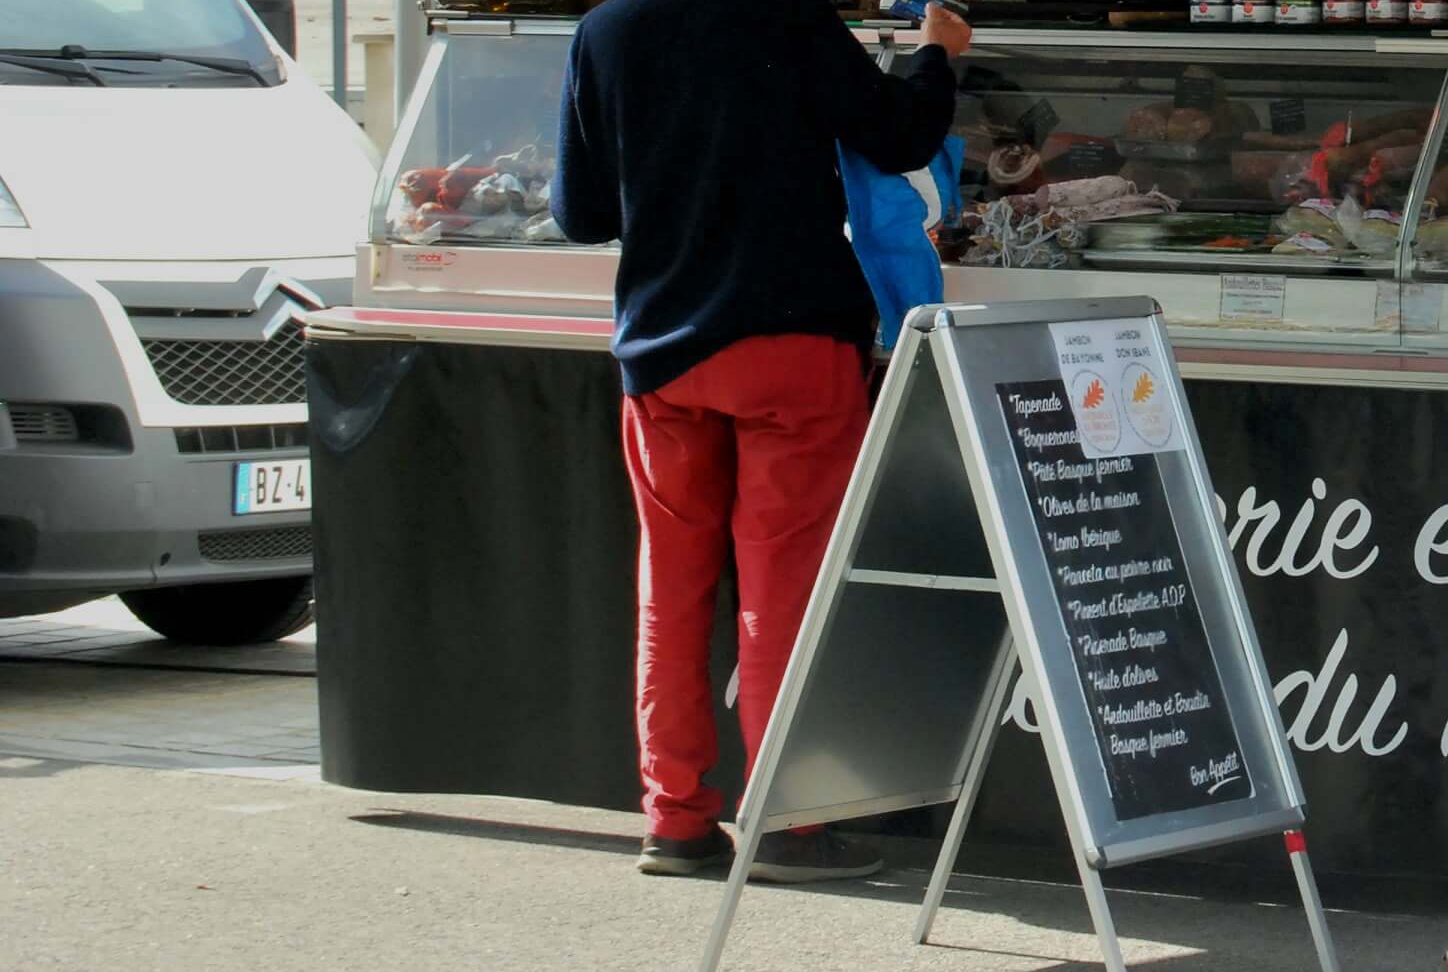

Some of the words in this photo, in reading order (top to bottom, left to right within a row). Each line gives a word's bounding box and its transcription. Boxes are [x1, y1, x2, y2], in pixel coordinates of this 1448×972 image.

[1012, 390, 1064, 419] Tapenade
[1056, 457, 1095, 484] Basque
[1095, 455, 1134, 484] fermier
[1043, 495, 1075, 518] Olives
[1075, 492, 1089, 513] de
[1089, 492, 1103, 512] la
[1103, 490, 1141, 512] maison
[1052, 531, 1079, 553] Lomo
[1105, 566, 1120, 580] au
[1119, 560, 1152, 584] poivre
[1151, 555, 1174, 573] noir
[1073, 598, 1109, 622] Piment
[1108, 590, 1160, 618] d'Espelette
[1129, 627, 1168, 653] Basque
[1093, 669, 1122, 692] Huile
[1122, 664, 1159, 688] d'olives
[1272, 628, 1409, 757] du
[1103, 699, 1163, 726] Andouillette
[1164, 697, 1176, 716] et
[1175, 688, 1210, 714] Boudin
[1110, 731, 1148, 759] Basque
[1149, 728, 1189, 758] fermier
[1190, 763, 1209, 787] Bon
[1208, 751, 1240, 785] Appétit
